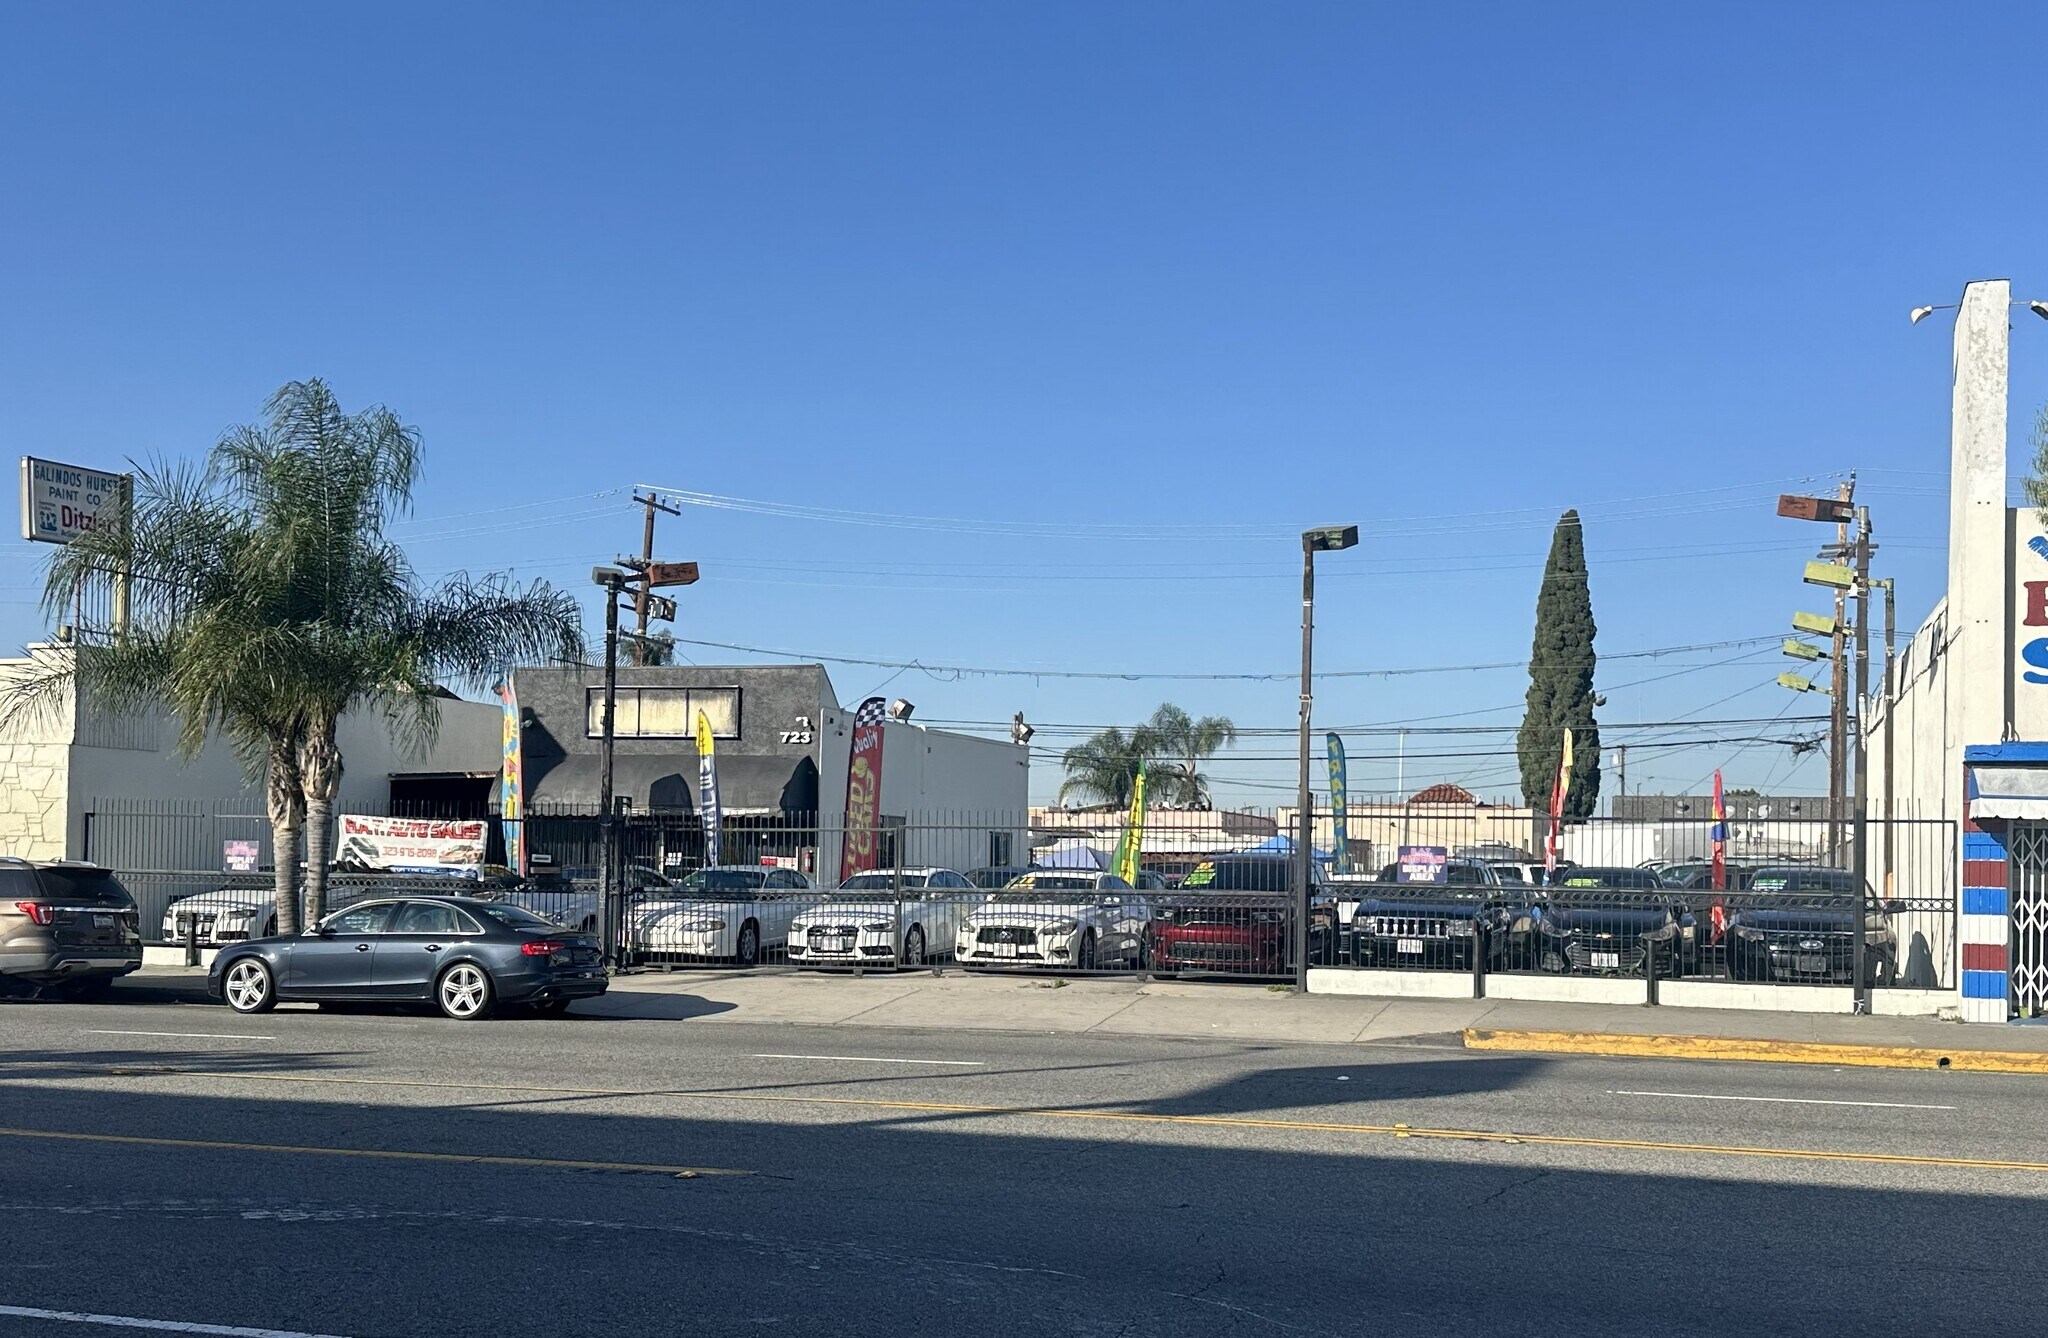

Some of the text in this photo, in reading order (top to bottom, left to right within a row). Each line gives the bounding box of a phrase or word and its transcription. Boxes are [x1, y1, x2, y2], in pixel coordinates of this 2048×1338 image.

[34, 464, 82, 488] GALINDOS
[49, 485, 79, 502] PAINT
[780, 731, 810, 744] 723
[387, 820, 430, 838] AUTO
[430, 823, 482, 840] SALES
[1402, 864, 1442, 874] DISPLAY
[1409, 872, 1435, 882] AREA
